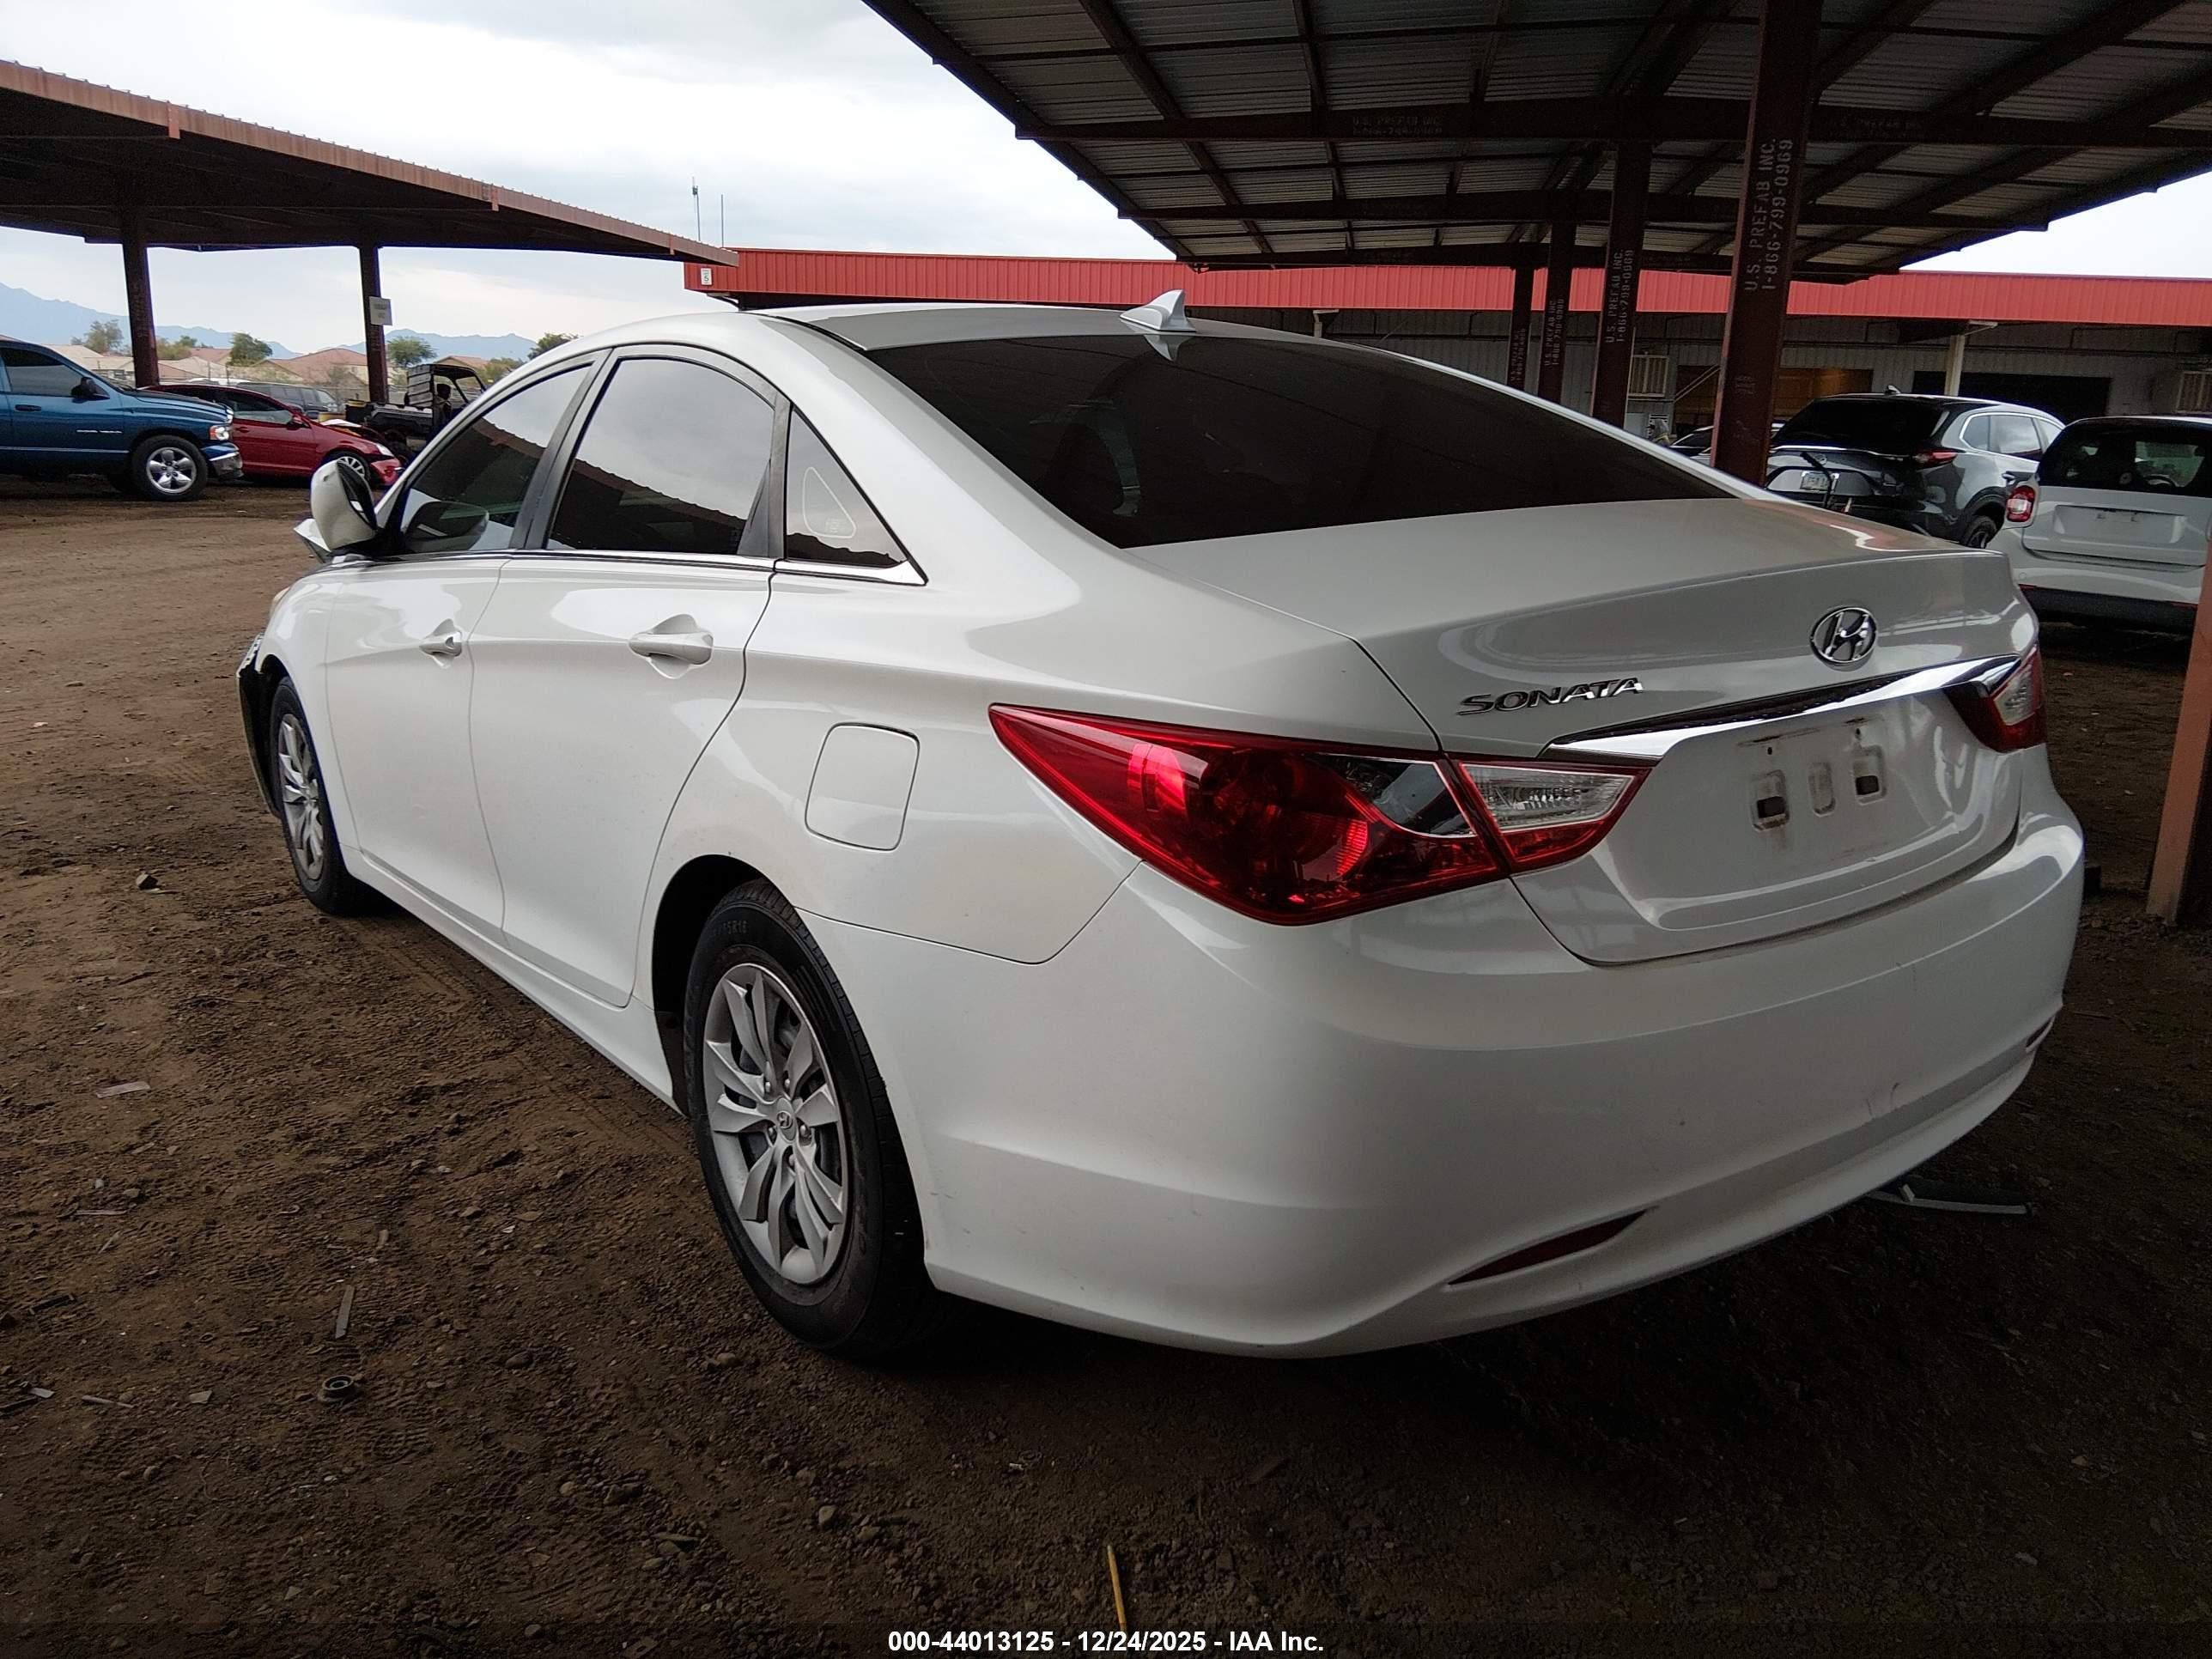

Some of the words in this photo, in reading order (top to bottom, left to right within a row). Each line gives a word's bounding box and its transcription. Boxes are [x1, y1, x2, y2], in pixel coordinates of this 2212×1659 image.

[1758, 138, 1777, 171] INC.
[1748, 180, 1771, 248] PREFAB
[1760, 138, 1794, 290] 1-866-799-0969
[1744, 258, 1762, 291] U.S.
[1458, 677, 1644, 714] SONATA
